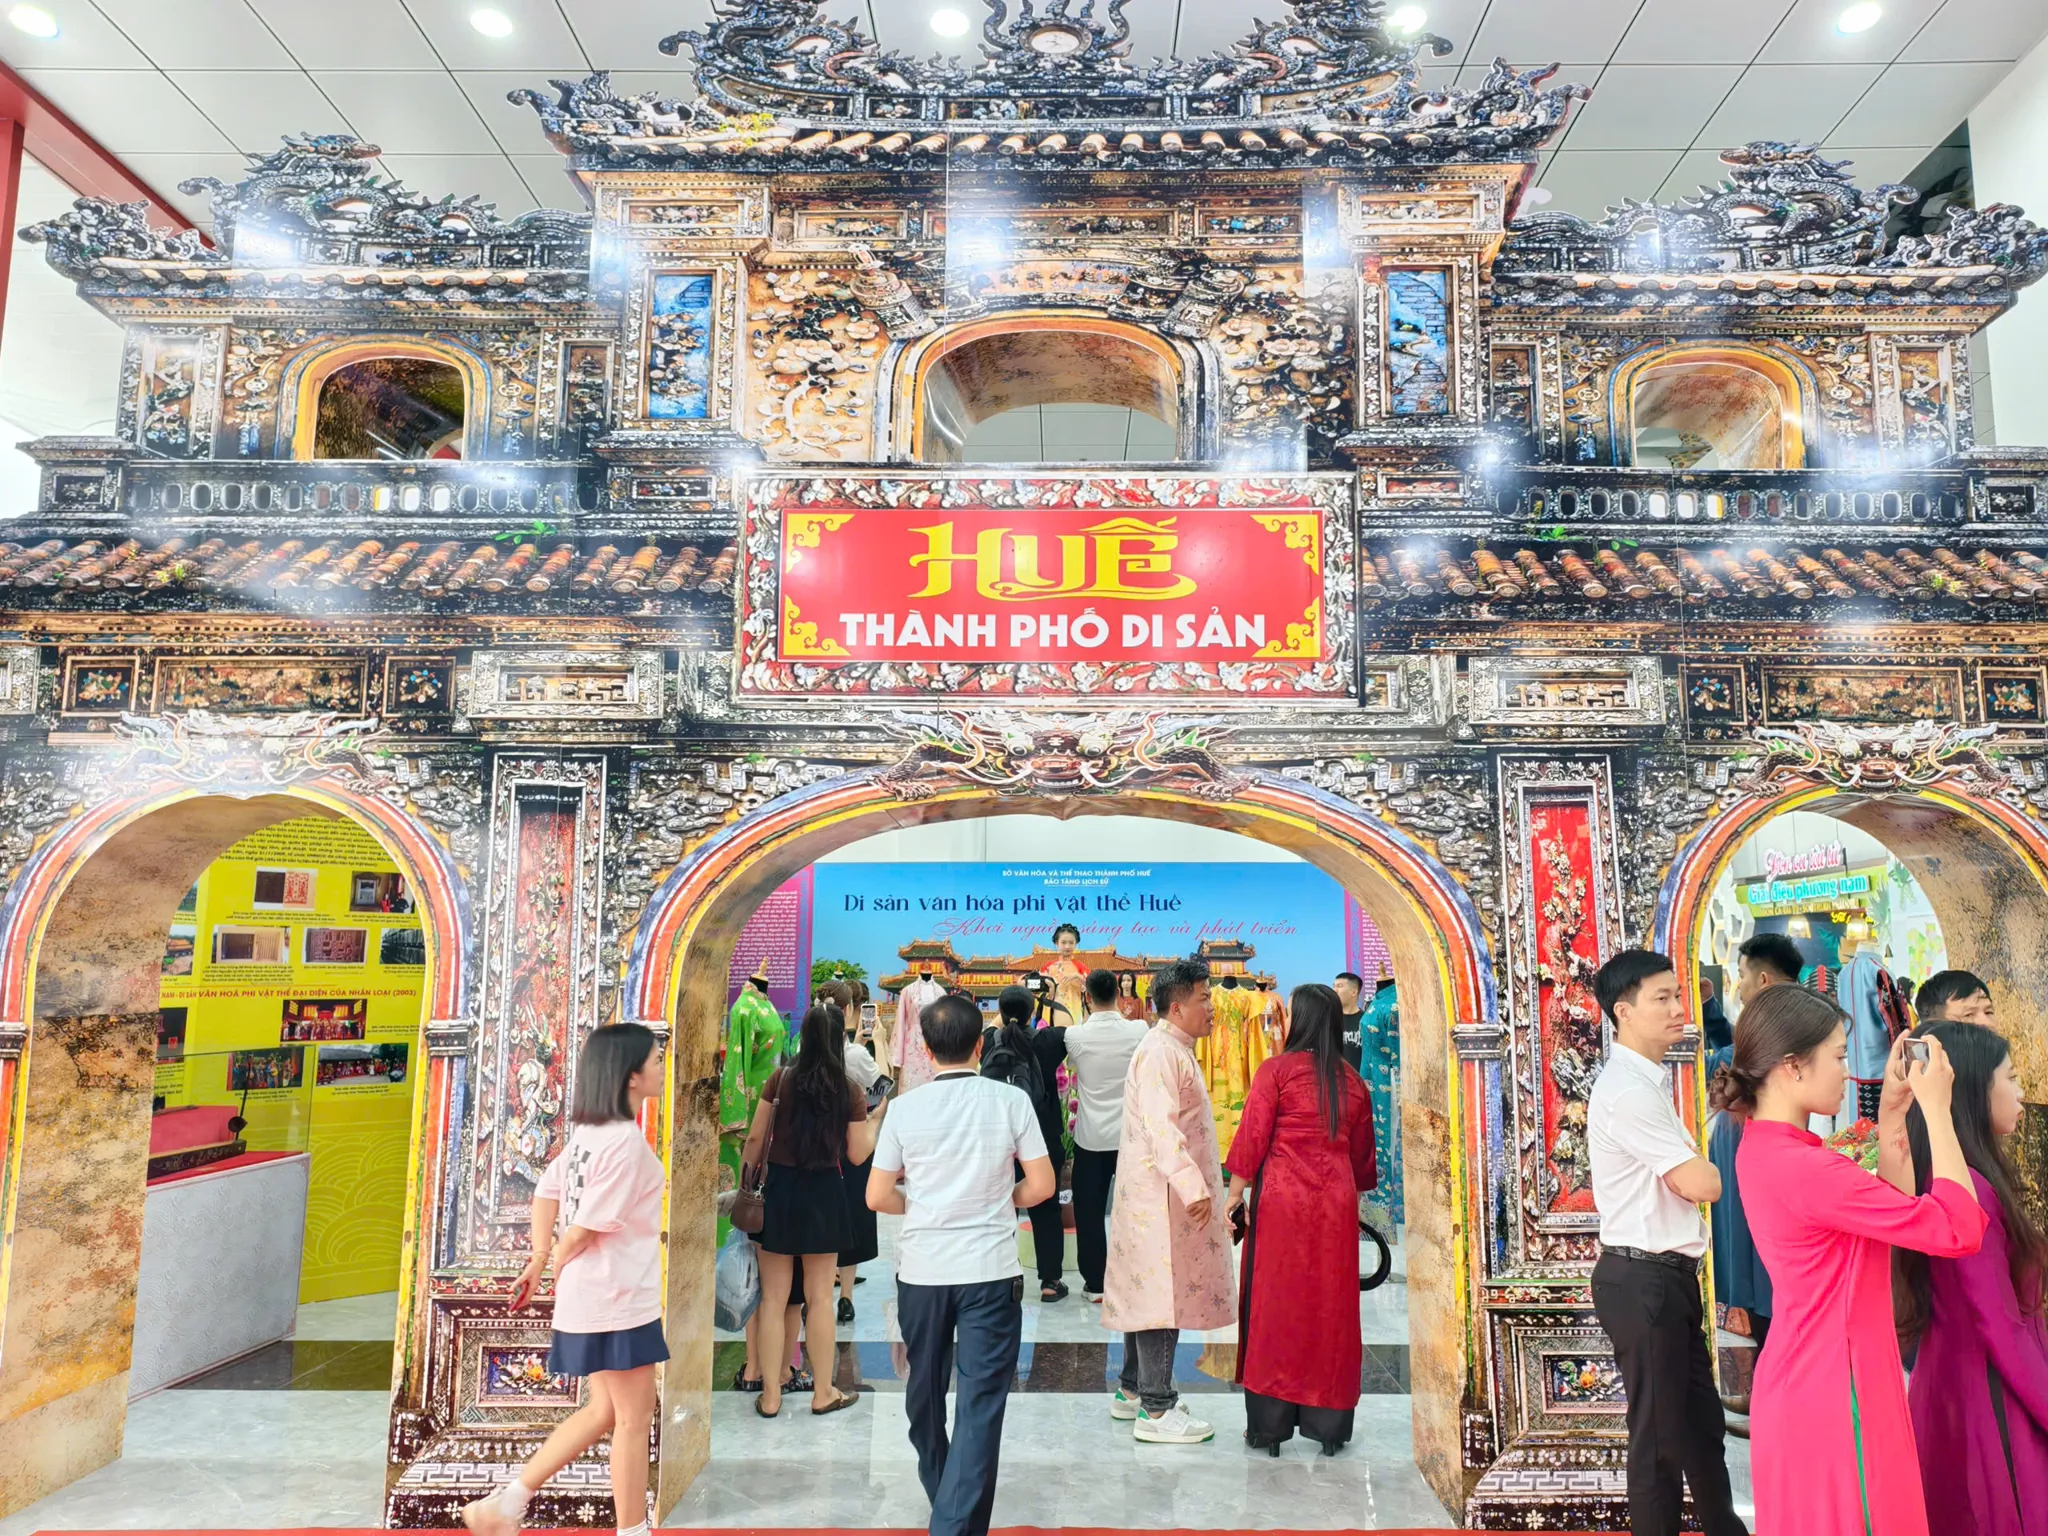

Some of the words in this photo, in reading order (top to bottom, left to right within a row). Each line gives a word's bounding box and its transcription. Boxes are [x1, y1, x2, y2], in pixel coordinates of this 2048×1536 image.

[839, 608, 997, 648] THÀNH
[1009, 606, 1109, 648] PHỐ
[1121, 613, 1163, 648] DI
[1175, 606, 1266, 648] SẢN
[1014, 869, 1029, 877] VĂN
[1030, 868, 1047, 877] HÓA
[1048, 869, 1059, 877] VÀ
[1074, 869, 1094, 877] THAO
[1095, 869, 1119, 877] THÀNH
[1120, 868, 1136, 877] PHỐ
[1136, 868, 1152, 877] HUẾ
[1061, 877, 1080, 885] TÀNG
[1082, 878, 1098, 886] LỊCH
[1795, 877, 1838, 903] phương
[1839, 875, 1867, 893] nam
[844, 894, 864, 911] Di
[873, 894, 909, 911] sản
[918, 896, 957, 911] văn
[966, 894, 1004, 911] hóa
[1013, 894, 1045, 915] phi
[1055, 895, 1087, 914] vật
[1097, 892, 1131, 911] thể
[1131, 920, 1160, 937] tạo
[1169, 920, 1191, 935] và
[1195, 918, 1245, 941] phát
[1250, 919, 1298, 935] triển
[198, 989, 217, 998] VĂN
[241, 989, 256, 998] PHI
[258, 988, 274, 1000] VẬT
[292, 988, 307, 999] ĐẠI
[309, 987, 327, 998] DIỆN
[329, 987, 347, 997] CỦA
[348, 988, 371, 997] NHÂN
[373, 988, 391, 998] LOẠI
[393, 988, 417, 998] (2003)
